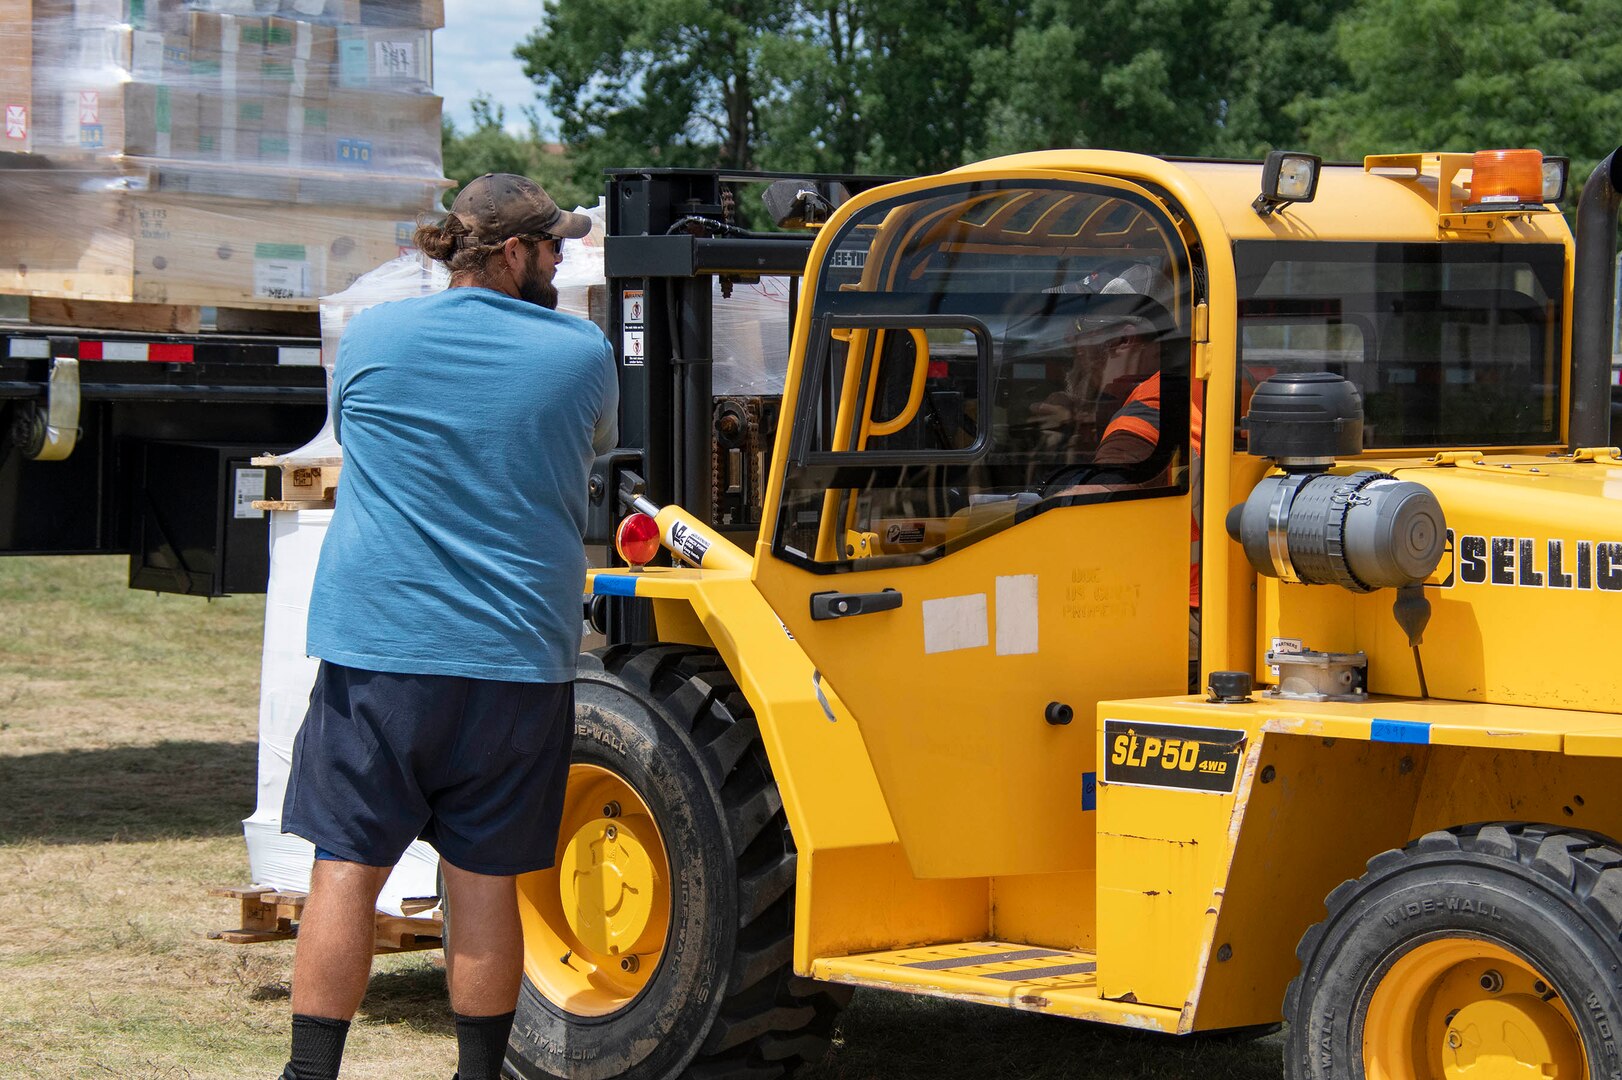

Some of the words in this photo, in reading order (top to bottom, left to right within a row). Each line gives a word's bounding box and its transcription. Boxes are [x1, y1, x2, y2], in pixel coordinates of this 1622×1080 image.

[574, 724, 625, 754] E-WALL
[1111, 728, 1200, 772] SLP50
[1198, 760, 1228, 774] 4WD
[1384, 897, 1503, 927] WIDE-WALL
